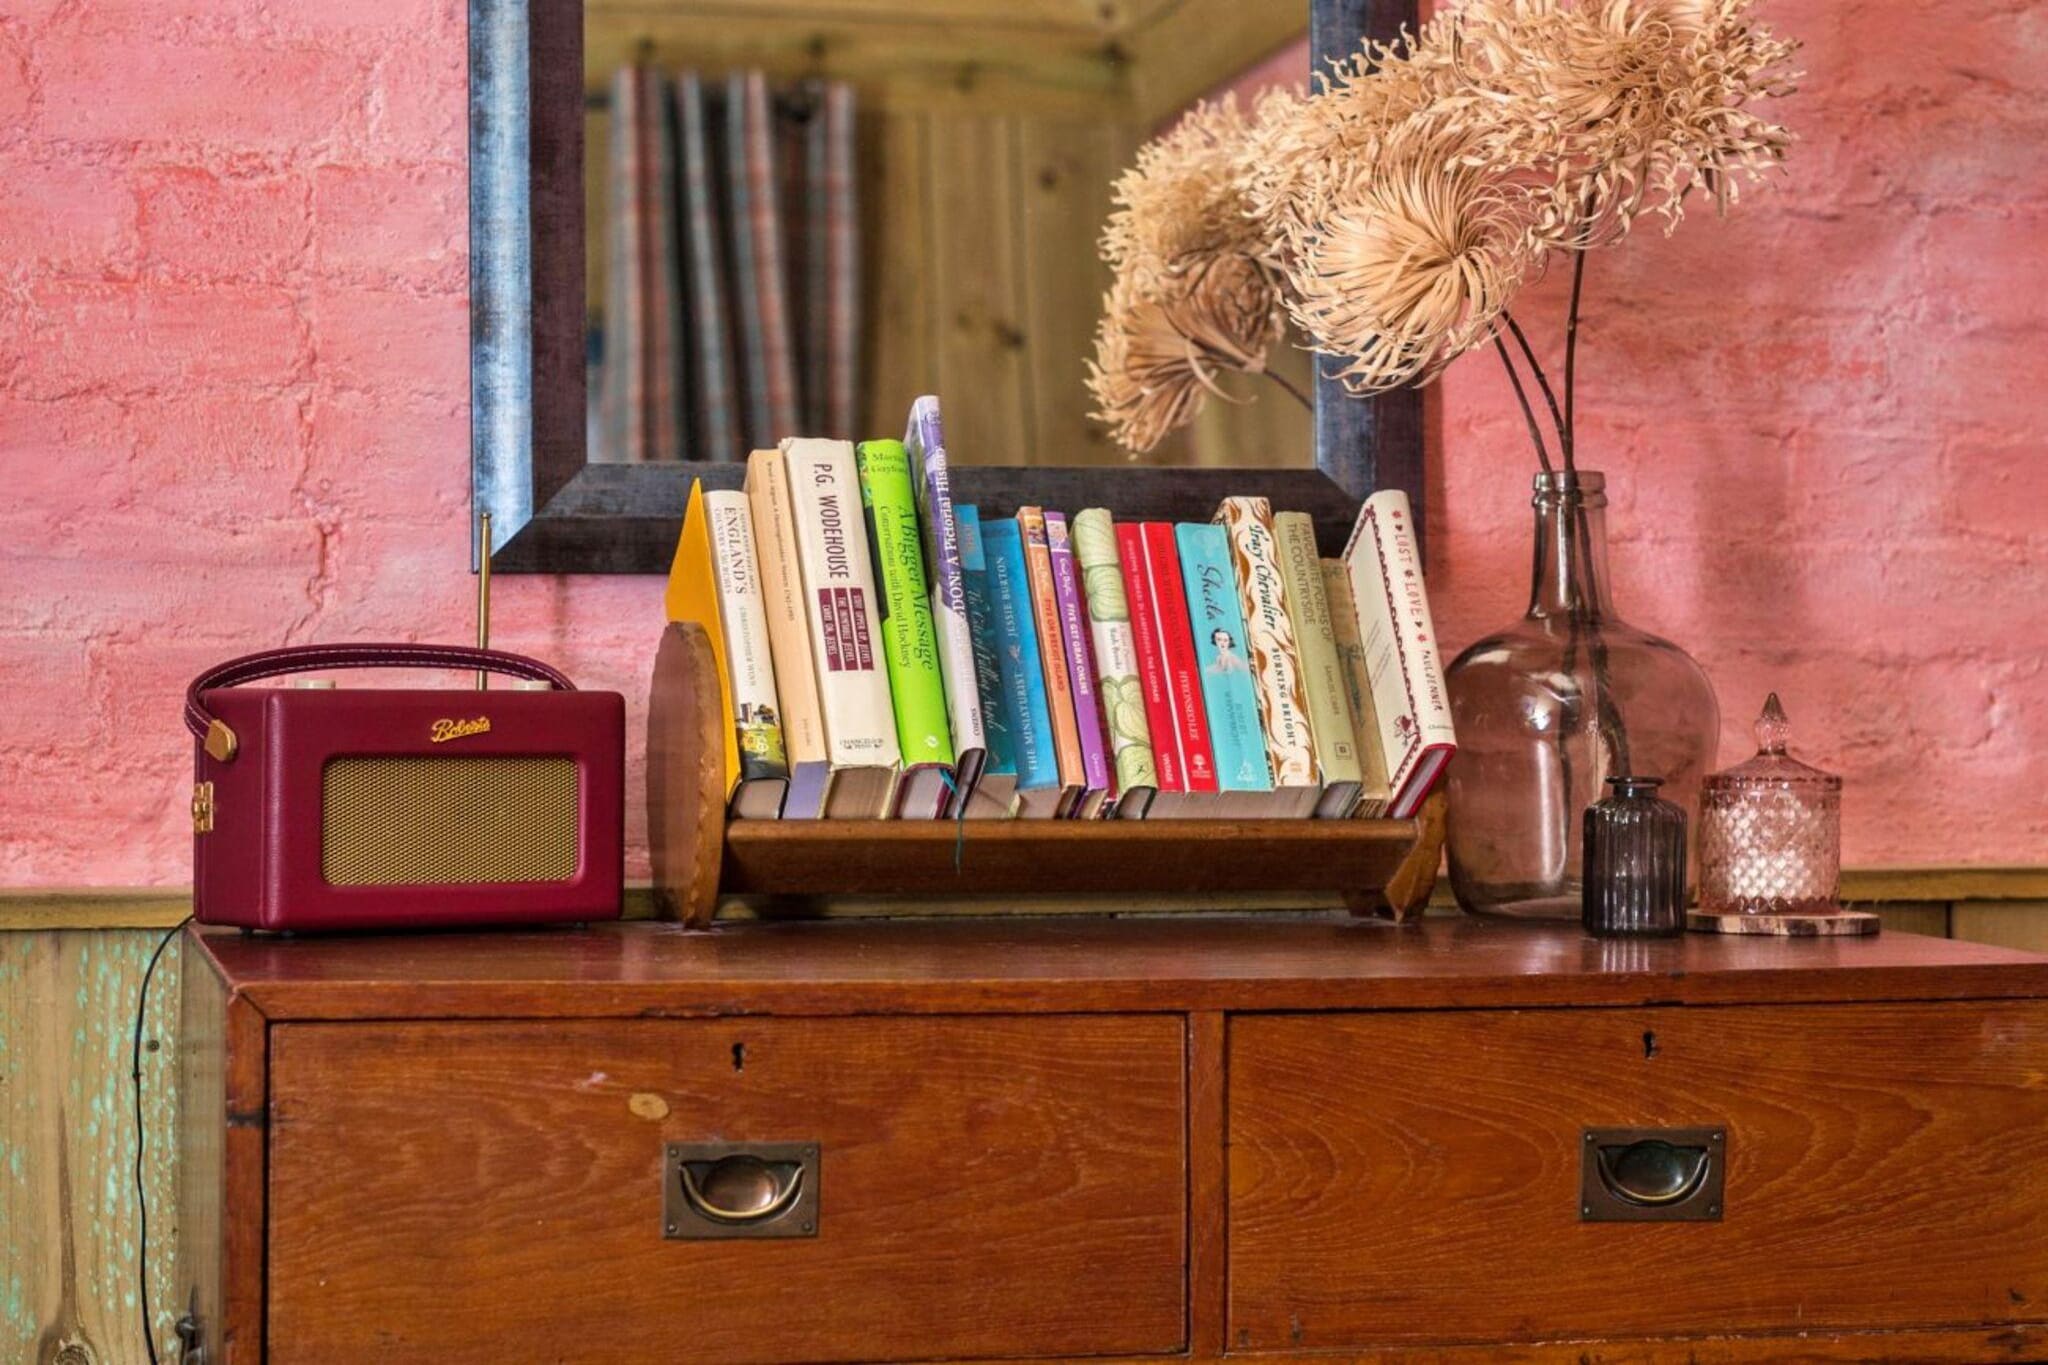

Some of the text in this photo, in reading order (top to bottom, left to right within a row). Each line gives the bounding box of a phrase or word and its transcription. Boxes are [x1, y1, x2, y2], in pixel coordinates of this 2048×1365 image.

[934, 446, 949, 491] History
[724, 507, 746, 594] ENGLAND'S
[812, 464, 849, 578] P.G. WODEHOUSE
[938, 497, 958, 551] Pictorial
[1300, 522, 1321, 583] FAVOURITE
[880, 505, 912, 668] Conversations with David Hockney
[897, 505, 934, 670] A Bigger Message
[946, 556, 961, 566] A
[996, 556, 1015, 636] JESSIE BURTON
[1197, 563, 1224, 620] Sheila
[1245, 525, 1283, 630] Tracy Chevalier
[1287, 523, 1316, 625] THE COUNTRYSIDE
[837, 597, 847, 608] THE
[1065, 603, 1076, 620] FIVE
[1068, 622, 1079, 638] GET
[430, 715, 491, 742] Roberts
[1014, 674, 1038, 770] THE MINIATURIST
[1271, 647, 1287, 699] BURNING
[1281, 703, 1296, 747] BRIGHT
